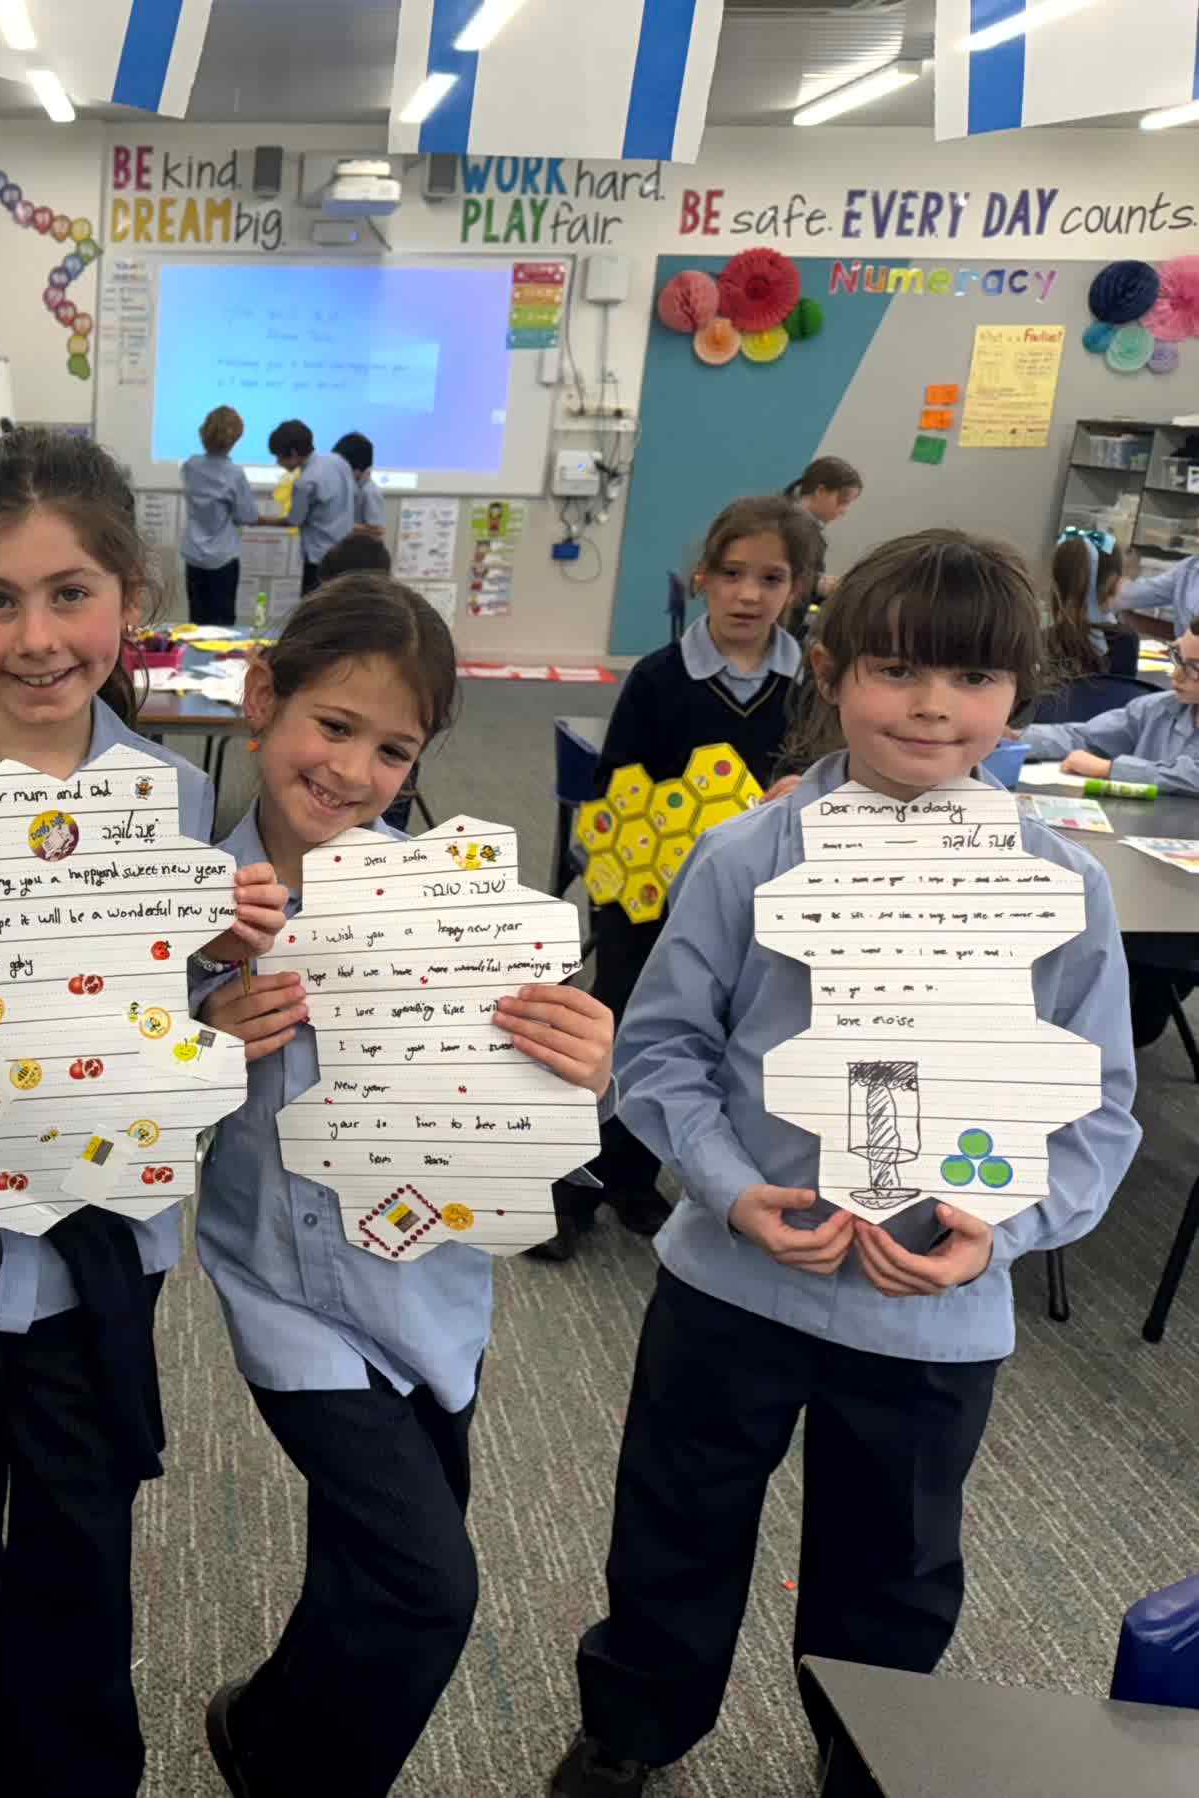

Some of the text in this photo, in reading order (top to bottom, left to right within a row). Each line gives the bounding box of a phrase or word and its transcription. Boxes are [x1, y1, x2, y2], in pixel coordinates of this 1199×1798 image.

[112, 145, 242, 191] BE kind.
[460, 156, 664, 200] WORK hard.
[111, 197, 287, 250] DREAM big.
[461, 199, 622, 245] PLAY fair.
[679, 188, 1199, 239] BE safe. EVERY DAY counts.
[828, 260, 1058, 303] Numeracy
[14, 791, 47, 801] mum
[57, 781, 82, 799] and
[20, 876, 42, 896] you
[122, 866, 158, 879] sweet
[162, 864, 190, 875] new
[21, 913, 30, 926] it
[38, 907, 61, 924] will
[69, 909, 84, 923] be
[92, 911, 102, 920] a
[177, 906, 202, 918] new
[325, 925, 354, 944] wish
[437, 919, 465, 942] happy
[467, 924, 490, 934] new
[495, 922, 522, 939] year
[837, 1015, 860, 1027] love
